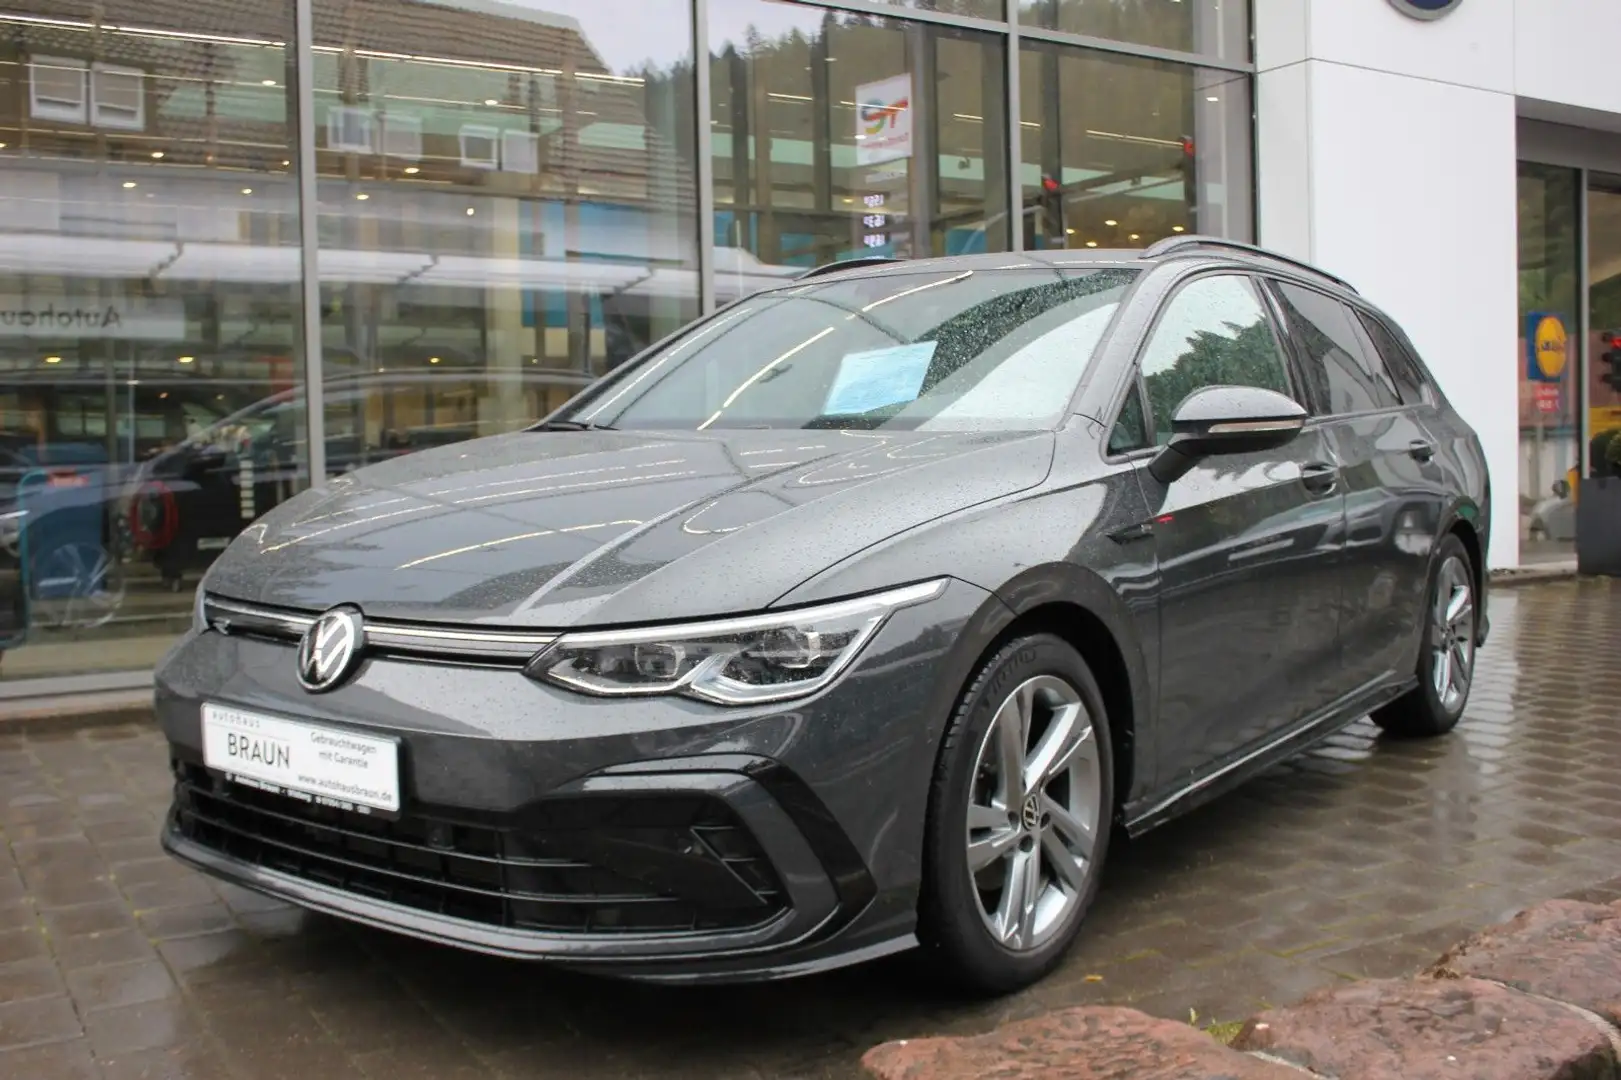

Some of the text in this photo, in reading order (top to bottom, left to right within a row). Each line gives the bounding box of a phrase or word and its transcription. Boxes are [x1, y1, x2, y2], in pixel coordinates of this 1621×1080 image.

[227, 732, 291, 769] BRAUN
[309, 731, 378, 756] Gebrauchtwagen
[319, 749, 369, 769] mit Garantie
[297, 774, 393, 802] www.autohausbraun.de
